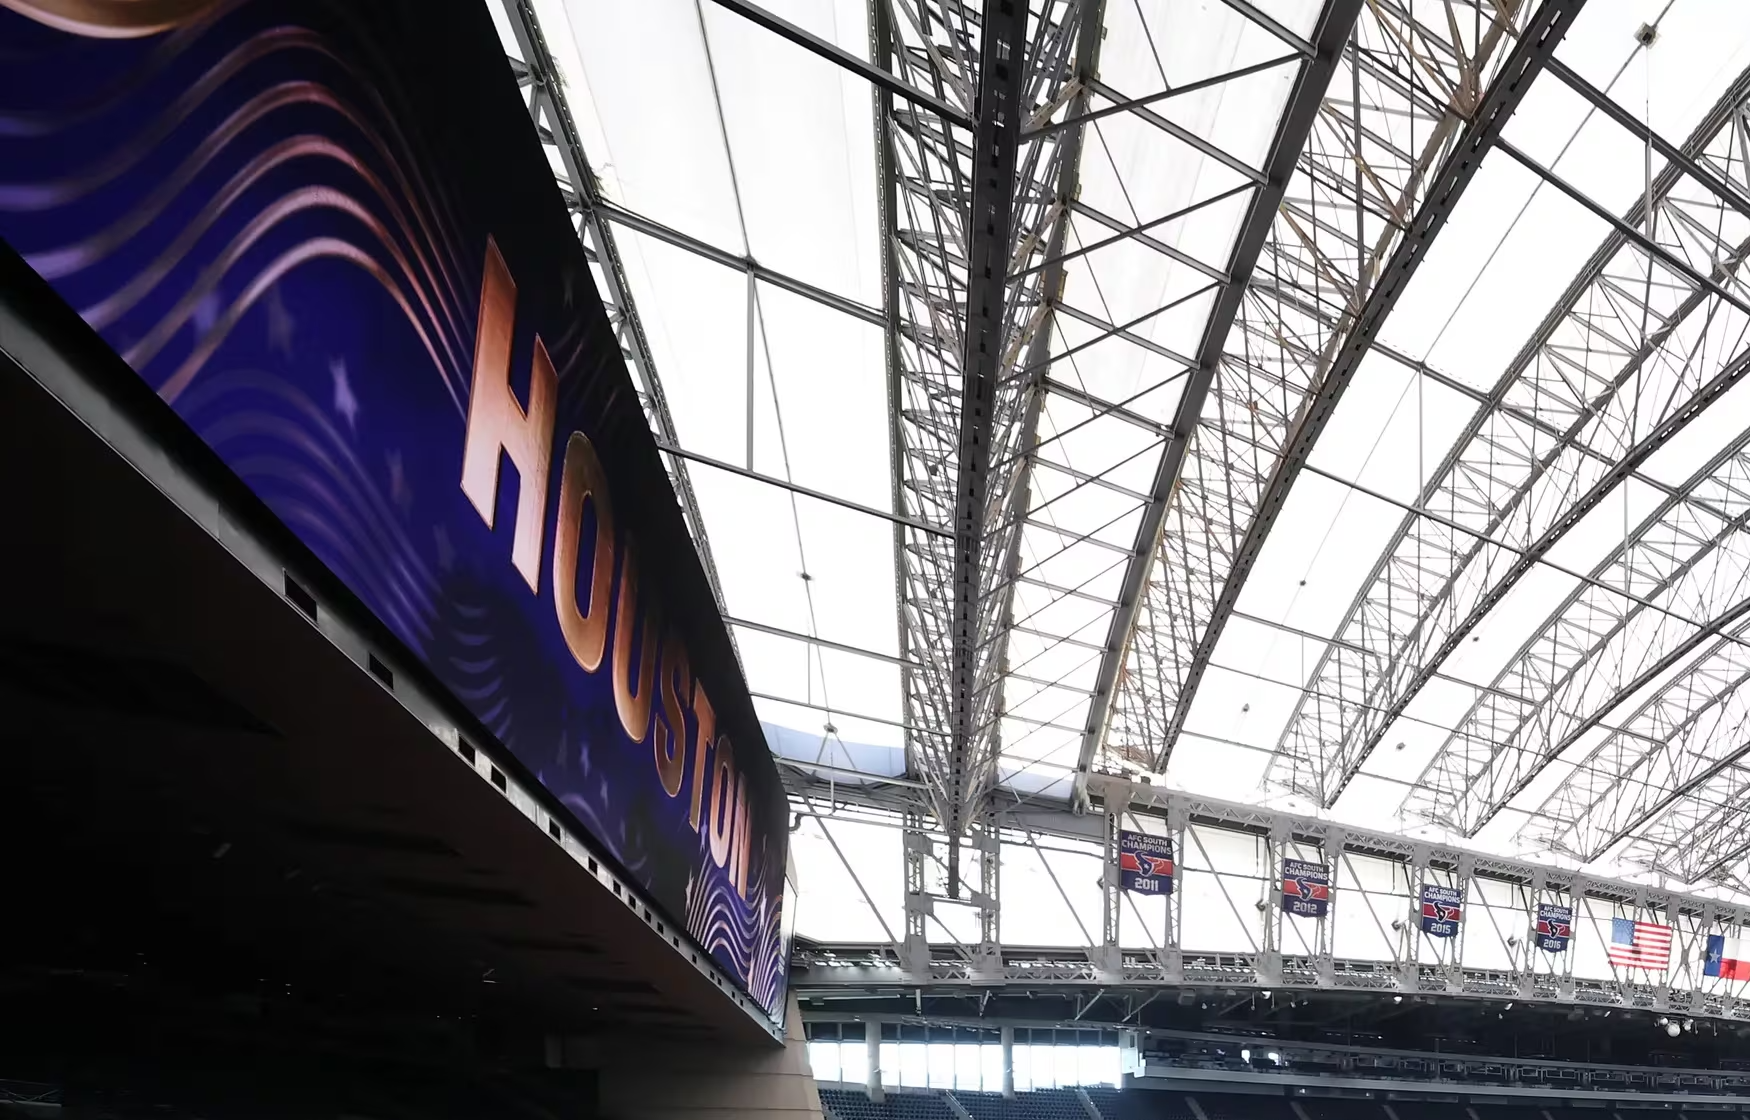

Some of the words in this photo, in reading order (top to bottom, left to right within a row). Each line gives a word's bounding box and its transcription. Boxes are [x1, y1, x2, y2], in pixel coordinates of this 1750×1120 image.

[460, 234, 753, 897] HOUSTON
[1128, 834, 1142, 842] AFC
[1143, 837, 1168, 847] SOUTH
[1122, 840, 1172, 855] CHAMPIONS
[1285, 866, 1328, 880] CHAMPIONS
[1302, 864, 1324, 872] SOUTH
[1135, 878, 1159, 891] 2011
[1424, 891, 1460, 904] CHAMPIONS
[1293, 901, 1317, 914] 2012
[1540, 910, 1571, 920] CHAMPIONS
[1431, 922, 1451, 934] 2015
[1543, 939, 1561, 949] 2016
